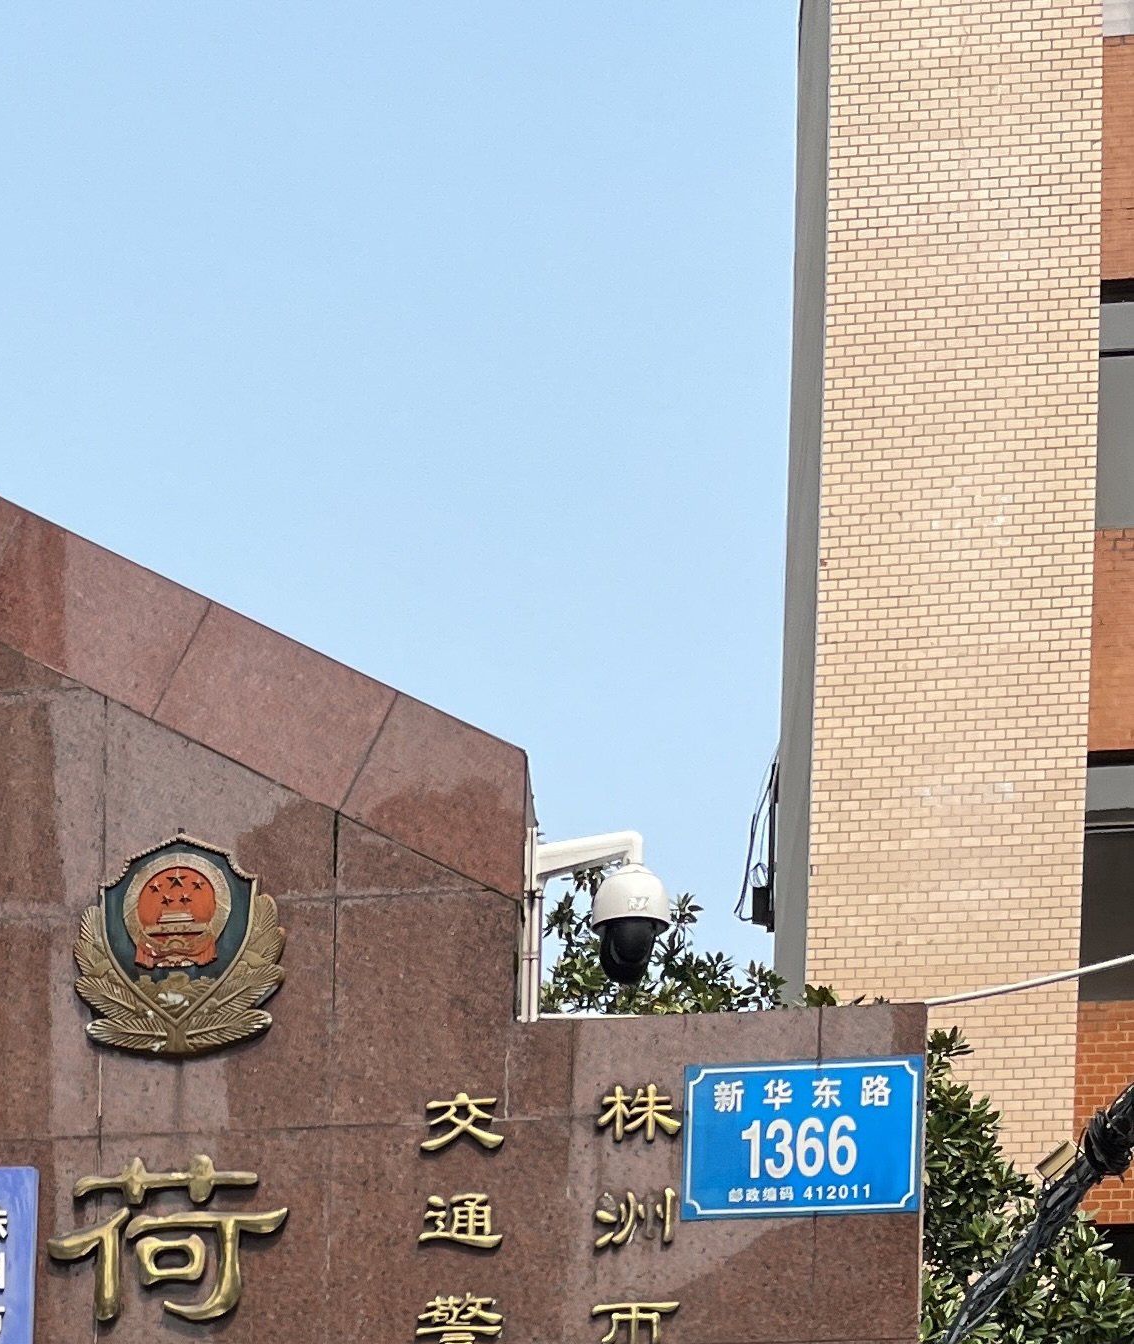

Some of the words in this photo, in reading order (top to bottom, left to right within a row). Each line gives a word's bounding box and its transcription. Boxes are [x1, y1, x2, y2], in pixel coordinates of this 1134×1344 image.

[714, 1075, 891, 1112] 新华东路
[741, 1115, 857, 1179] 1366
[728, 1186, 794, 1203] 邮政编码
[803, 1184, 871, 1200] 412011
